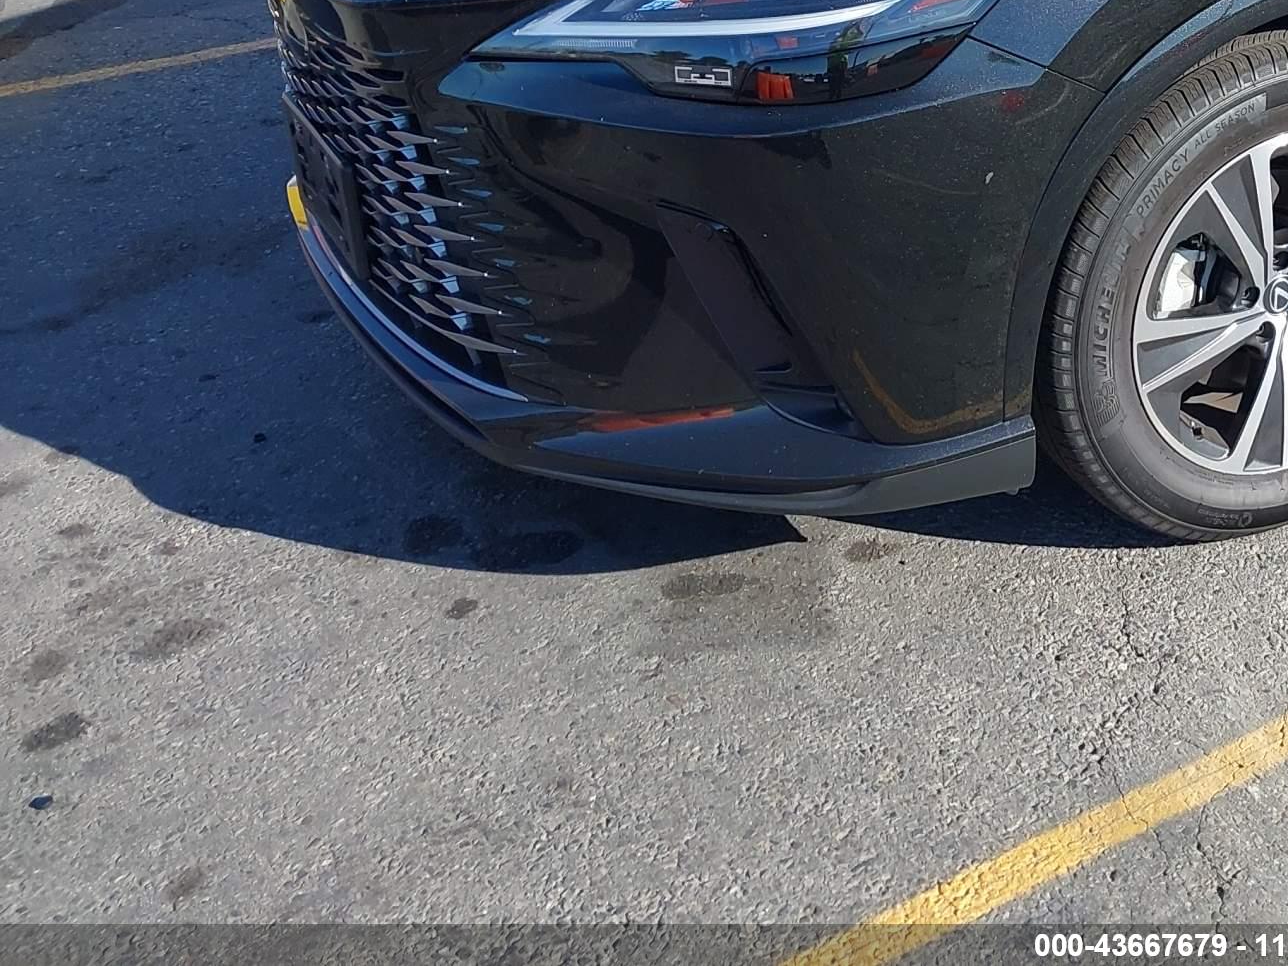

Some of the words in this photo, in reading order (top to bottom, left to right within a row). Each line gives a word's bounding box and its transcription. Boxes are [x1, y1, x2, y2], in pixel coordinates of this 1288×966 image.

[1136, 148, 1189, 218] PRIMACY
[1193, 130, 1213, 149] ALL
[1214, 102, 1255, 133] SEASON
